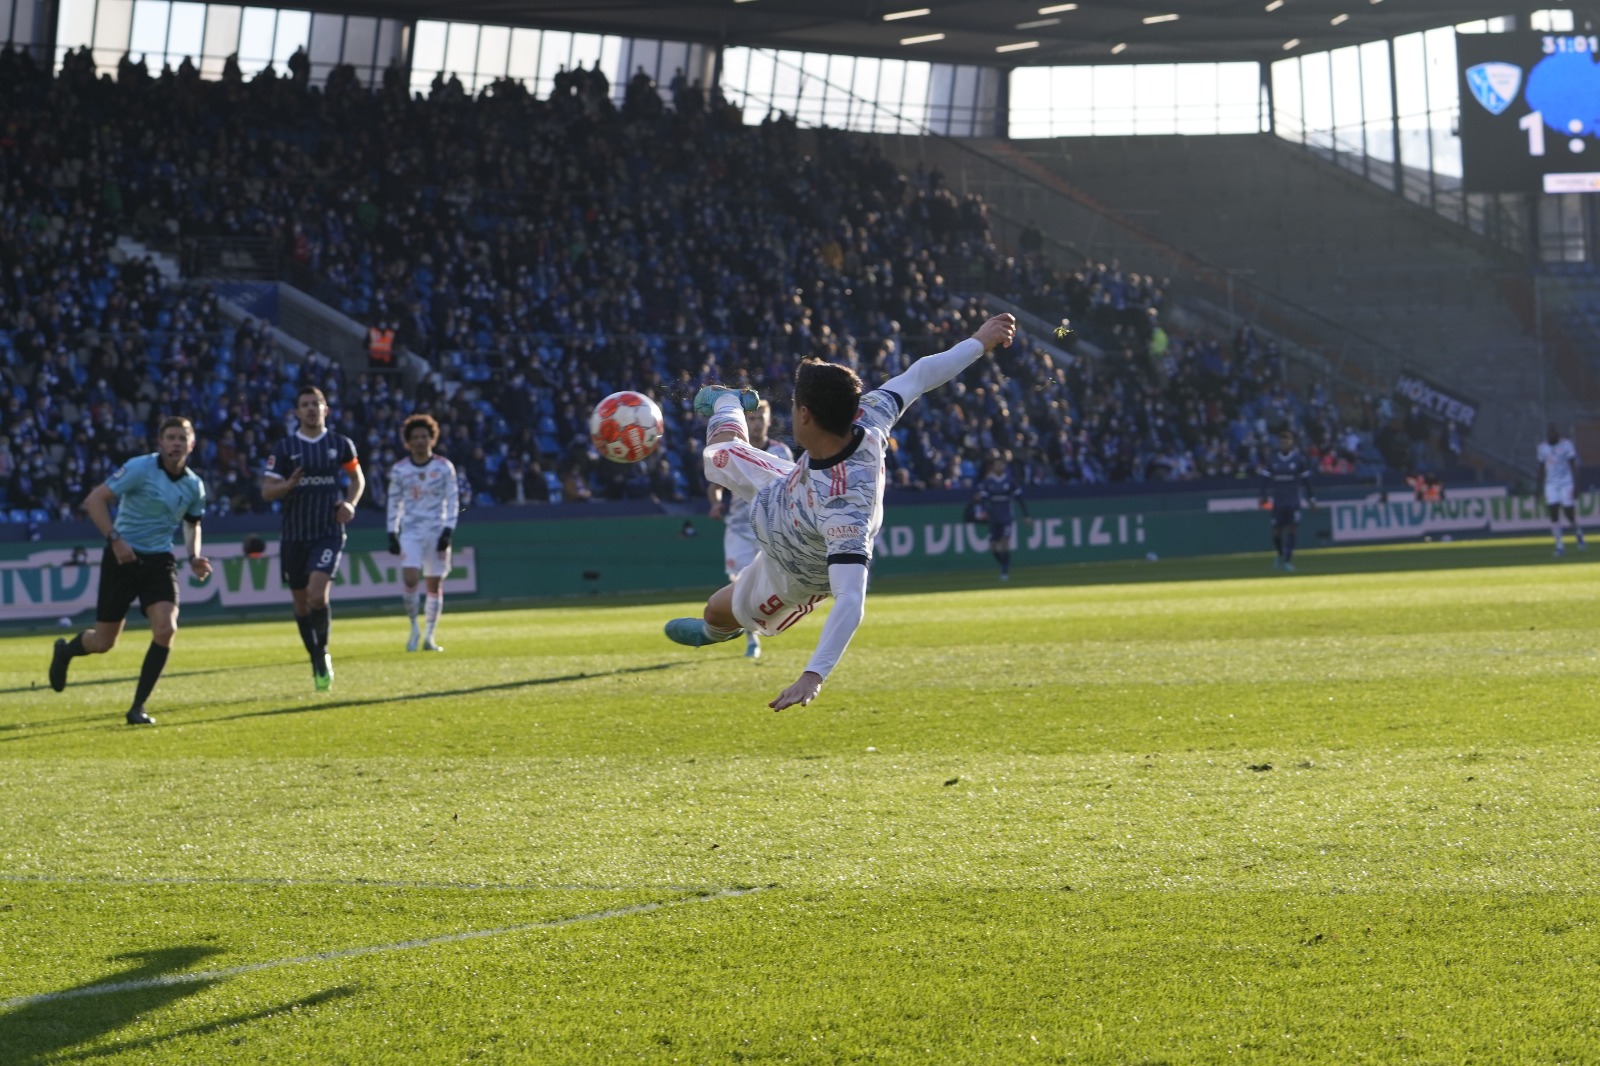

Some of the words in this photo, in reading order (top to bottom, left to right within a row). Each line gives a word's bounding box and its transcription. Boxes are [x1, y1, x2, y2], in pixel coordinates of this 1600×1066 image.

[1541, 34, 1599, 54] 31:01
[826, 525, 860, 537] QATAR
[320, 548, 334, 564] 8
[759, 594, 786, 616] 9
